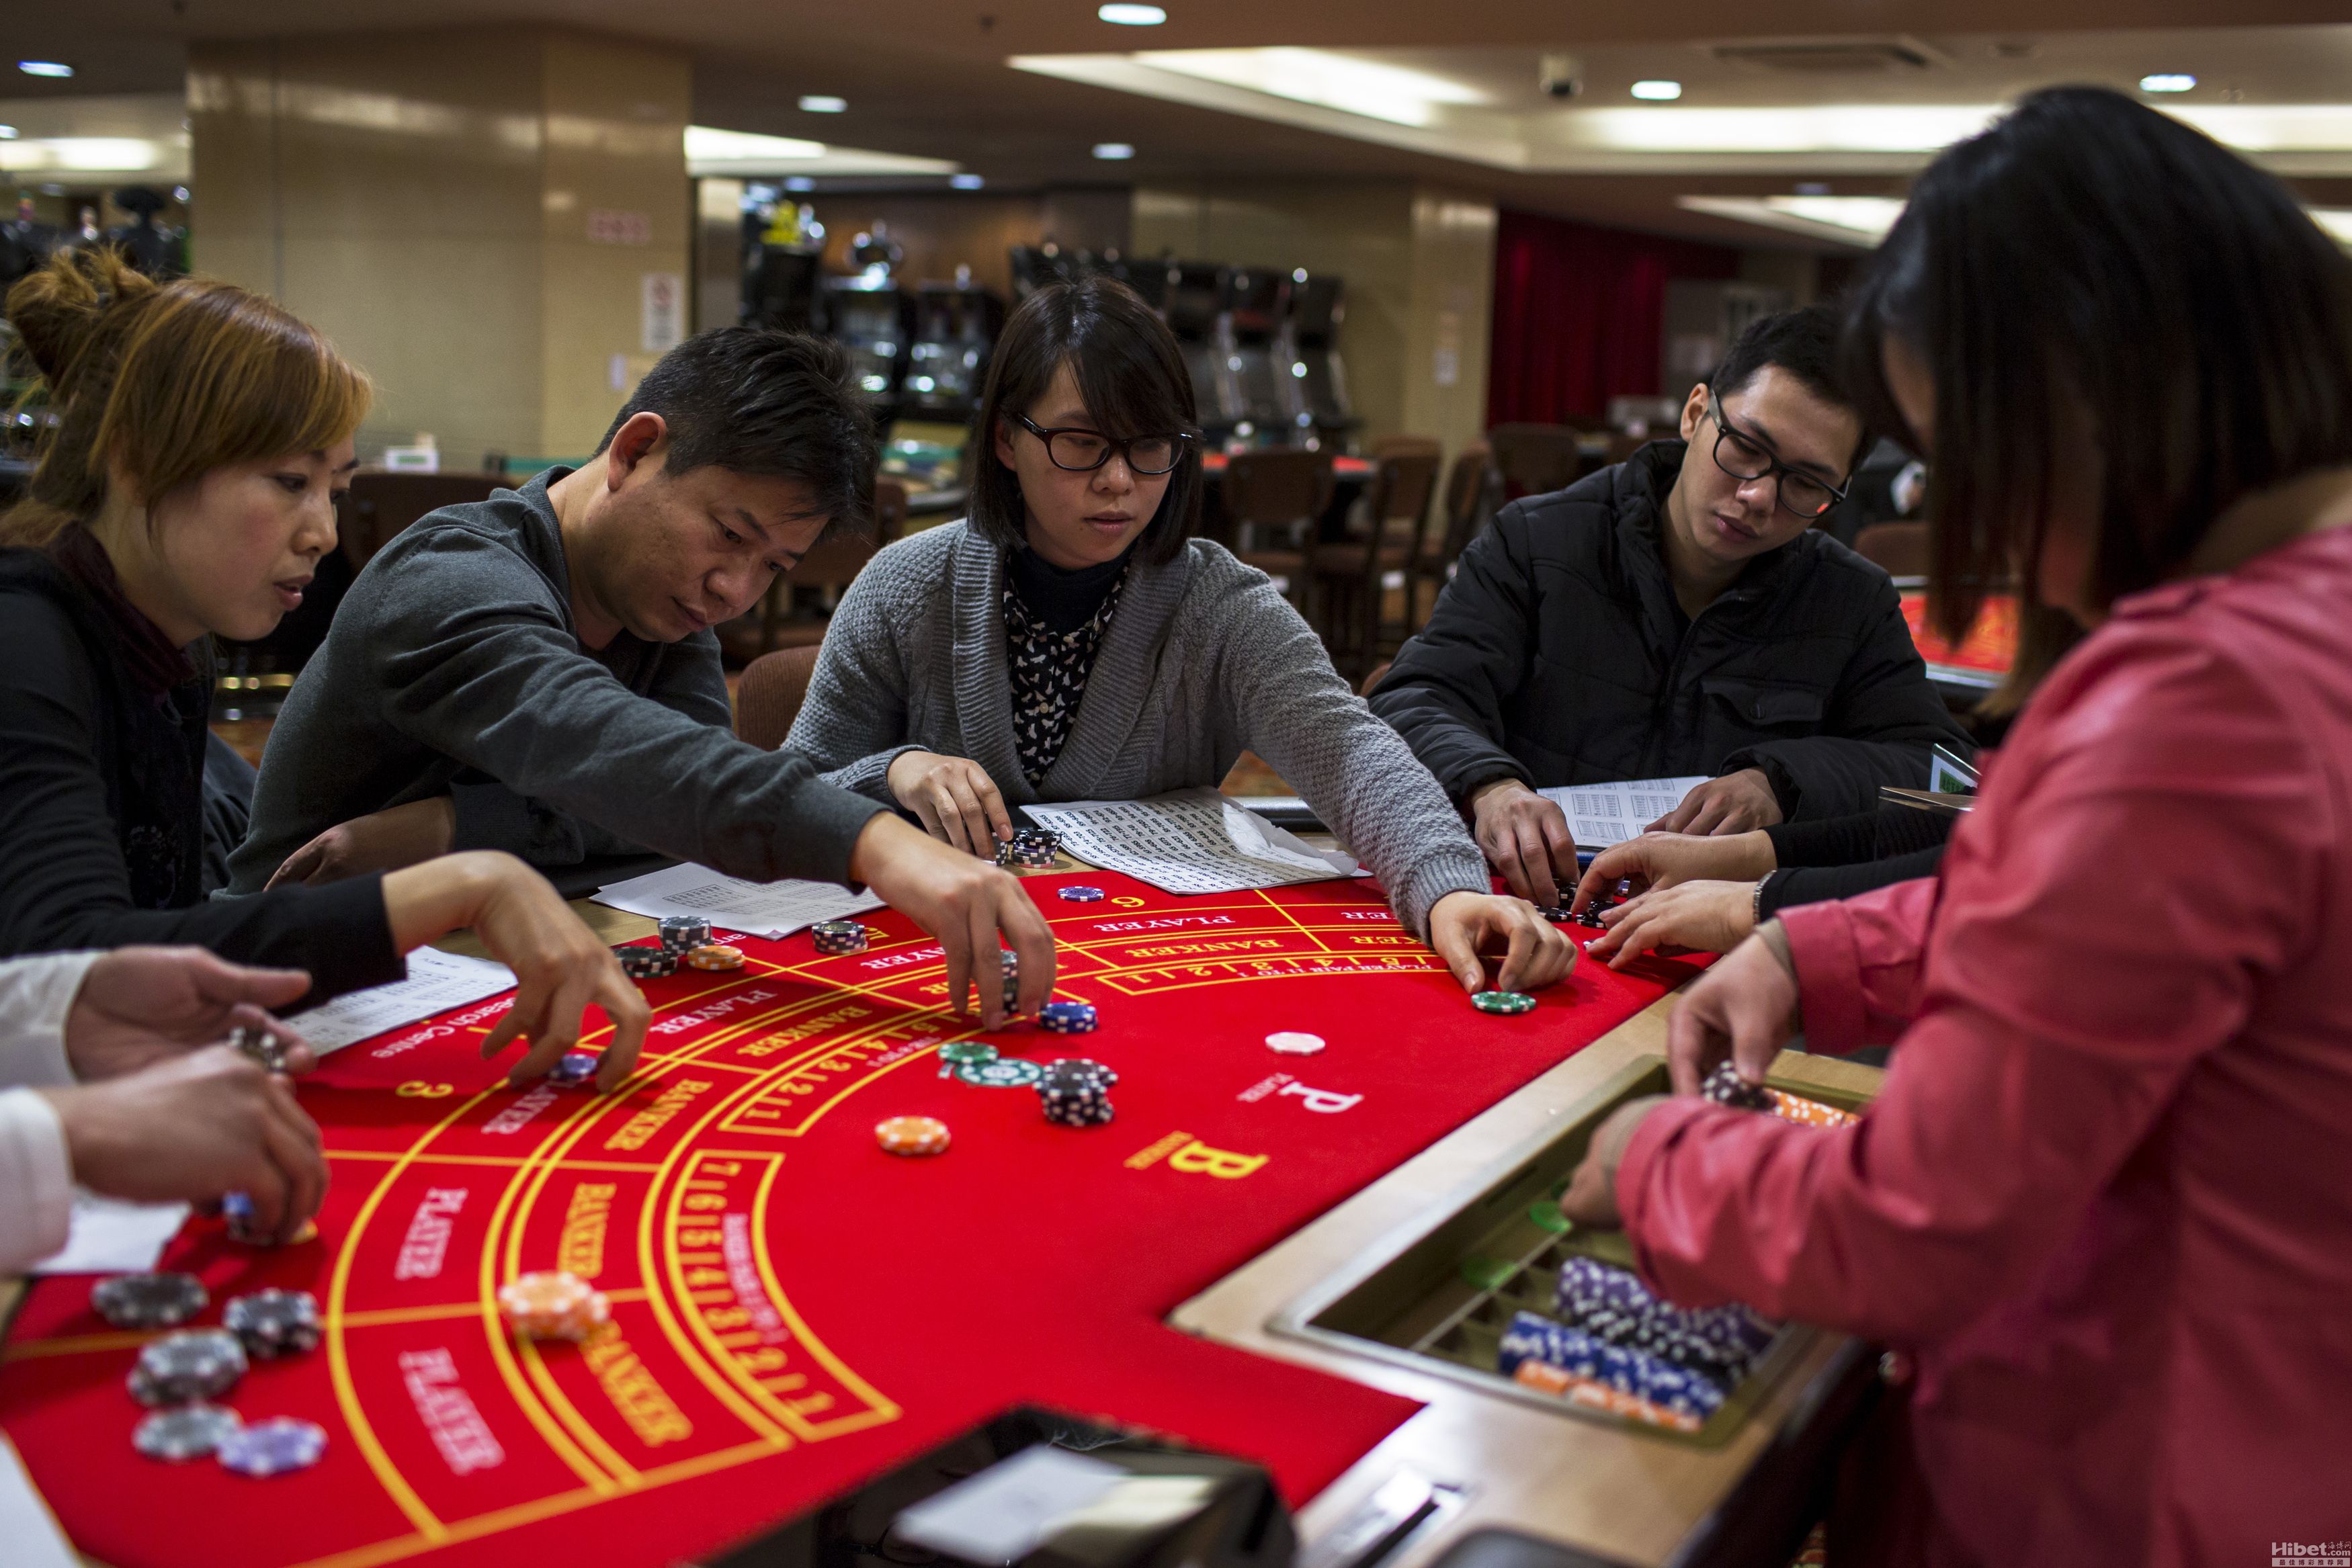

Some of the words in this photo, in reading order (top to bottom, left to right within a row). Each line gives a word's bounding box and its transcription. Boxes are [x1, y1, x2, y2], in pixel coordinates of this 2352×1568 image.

[1086, 829, 1105, 842] 75-7125
[1100, 828, 1118, 841] 76-722
[1127, 824, 1144, 837] 78-741
[1136, 820, 1158, 835] 79-7505
[1074, 832, 1091, 844] 74-703
[1171, 836, 1191, 849] 66-627
[1111, 896, 1145, 908] 6
[1092, 915, 1236, 932] PLAYER
[1125, 939, 1284, 958] BANKER
[1349, 936, 1421, 945] KER
[860, 947, 946, 969] AYER
[1250, 961, 1273, 971] 3
[1313, 957, 1334, 967] 4
[1381, 957, 1400, 966] 5
[1187, 965, 1213, 976] 2
[1258, 968, 1285, 977] TO
[1308, 965, 1355, 973] PAIR
[1357, 963, 1433, 972] PLAYER
[1126, 973, 1150, 984] 1
[650, 988, 778, 1035] PLAYER
[737, 1005, 873, 1057] BANKER
[911, 1022, 941, 1034] 5
[371, 1025, 455, 1058] Centre
[860, 1039, 889, 1051] 4
[818, 1059, 851, 1072] 3
[395, 1080, 454, 1099] 3
[778, 1080, 814, 1095] 2
[1278, 1080, 1365, 1113] P
[603, 1078, 714, 1151] BANKER
[745, 1101, 781, 1119] 1
[1168, 1139, 1270, 1179] B
[700, 1160, 741, 1177] 7
[683, 1193, 728, 1211] 6
[395, 1187, 468, 1280] PLAYER
[558, 1182, 616, 1278] BANKER
[685, 1266, 729, 1286] 4
[703, 1305, 751, 1330] 3
[732, 1347, 788, 1375] 2
[783, 1391, 835, 1415] 1
[399, 1347, 505, 1476] PLAYER
